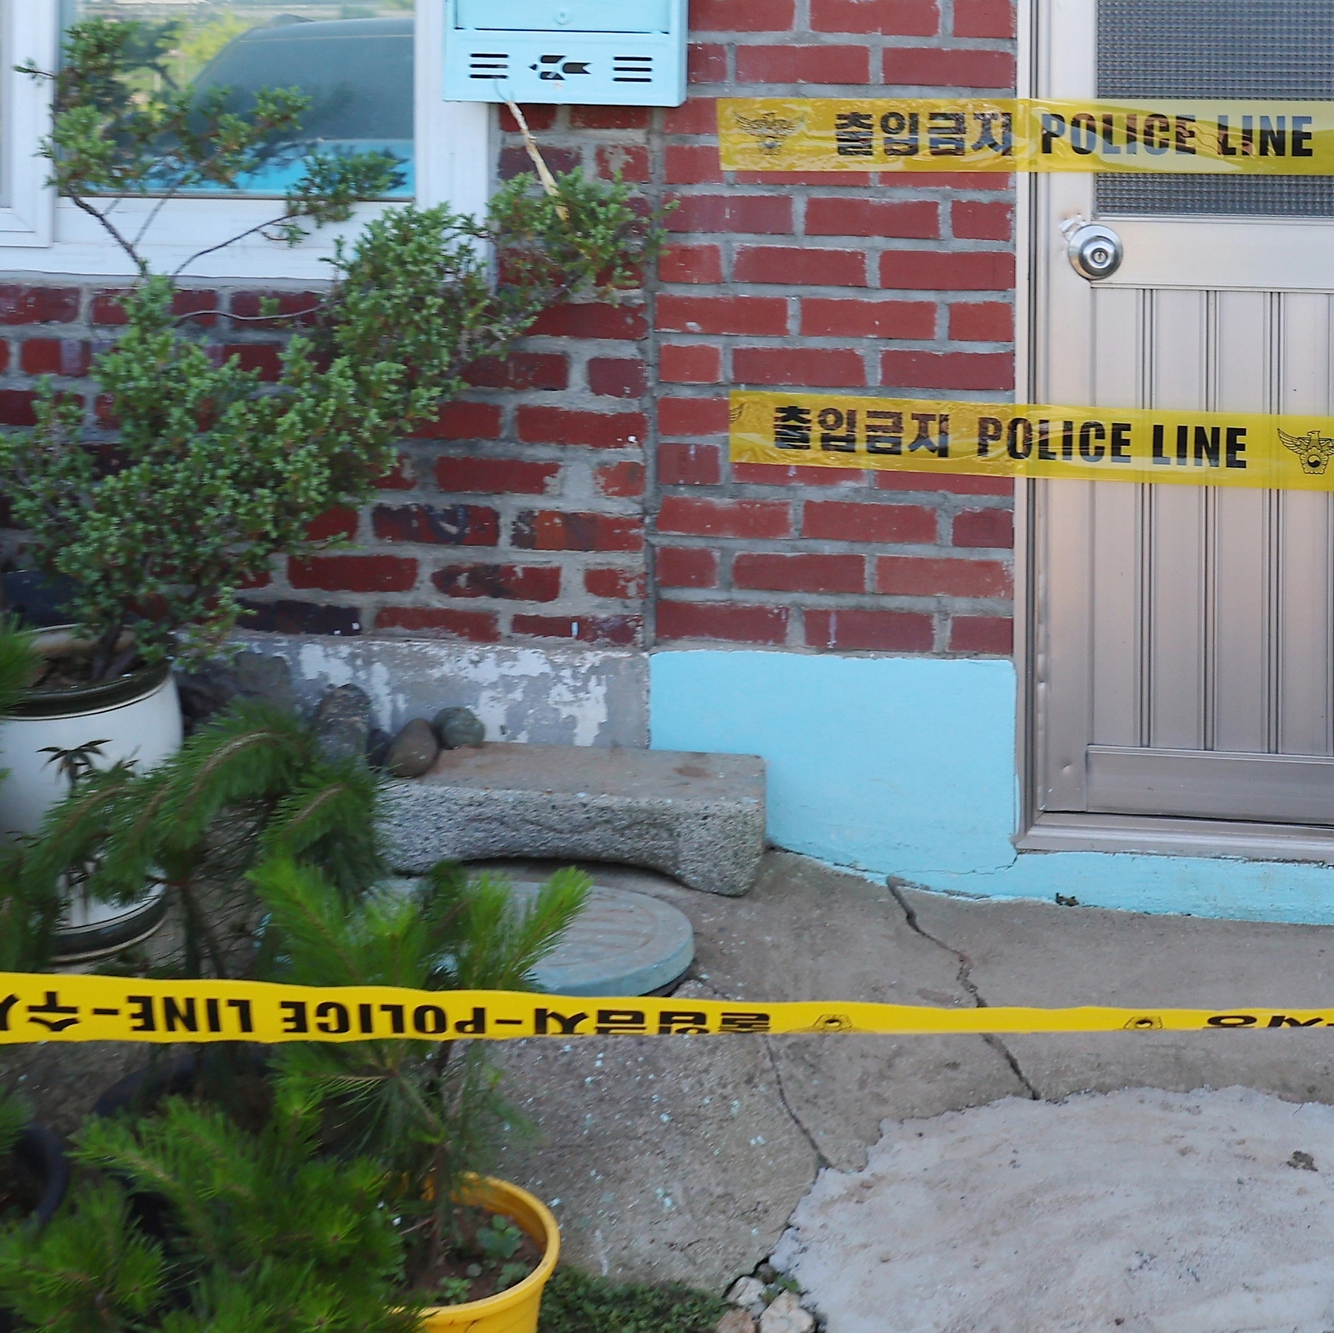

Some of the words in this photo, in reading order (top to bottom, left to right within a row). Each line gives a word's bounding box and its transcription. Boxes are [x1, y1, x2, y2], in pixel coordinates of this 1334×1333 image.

[834, 111, 1012, 157] 출입금지
[1041, 113, 1196, 156] POLICE
[1216, 115, 1314, 158] LINE
[773, 405, 949, 459] 출입금지
[977, 416, 1133, 459] POLICE
[1152, 425, 1247, 469] LINE
